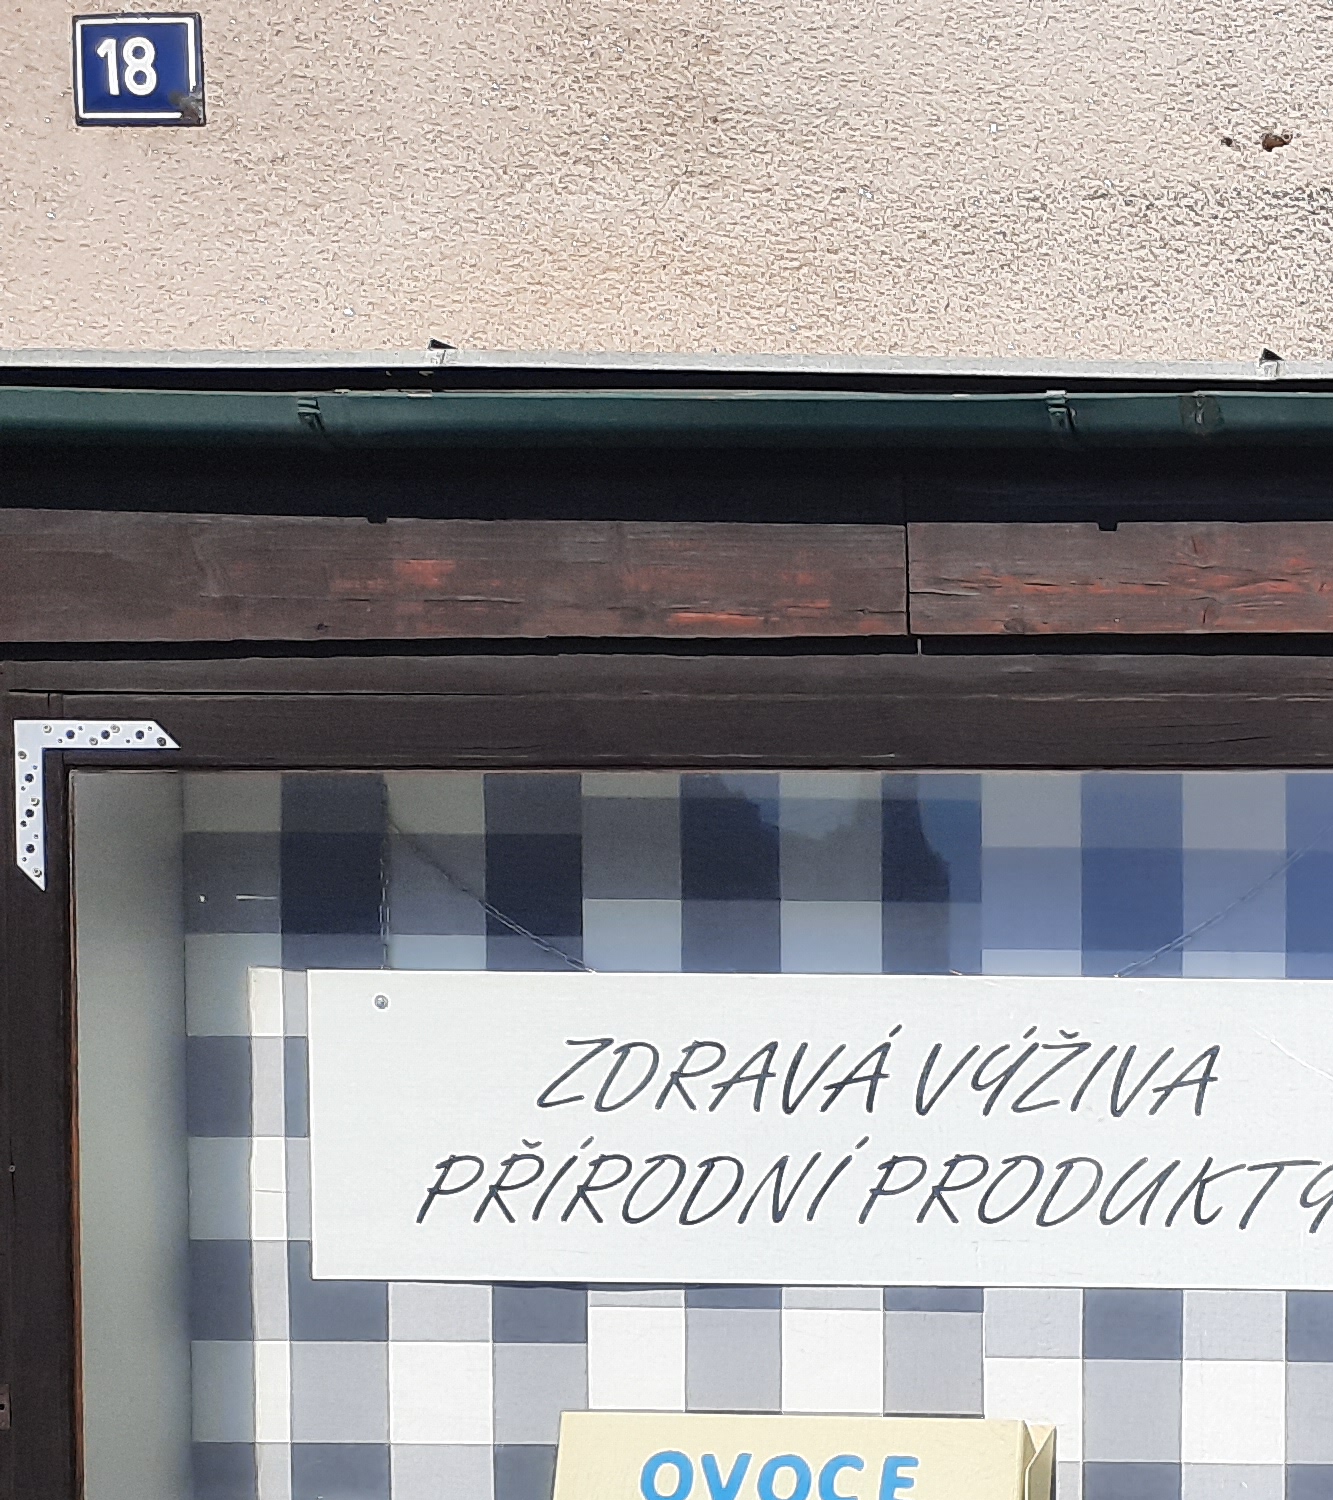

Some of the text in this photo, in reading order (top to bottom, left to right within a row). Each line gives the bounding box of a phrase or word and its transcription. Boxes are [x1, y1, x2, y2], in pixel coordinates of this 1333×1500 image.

[96, 36, 158, 96] 18
[536, 1024, 1223, 1119] ZDRAVÁ VÝŽIVA
[415, 1137, 871, 1226] PŘÍRODNÍ
